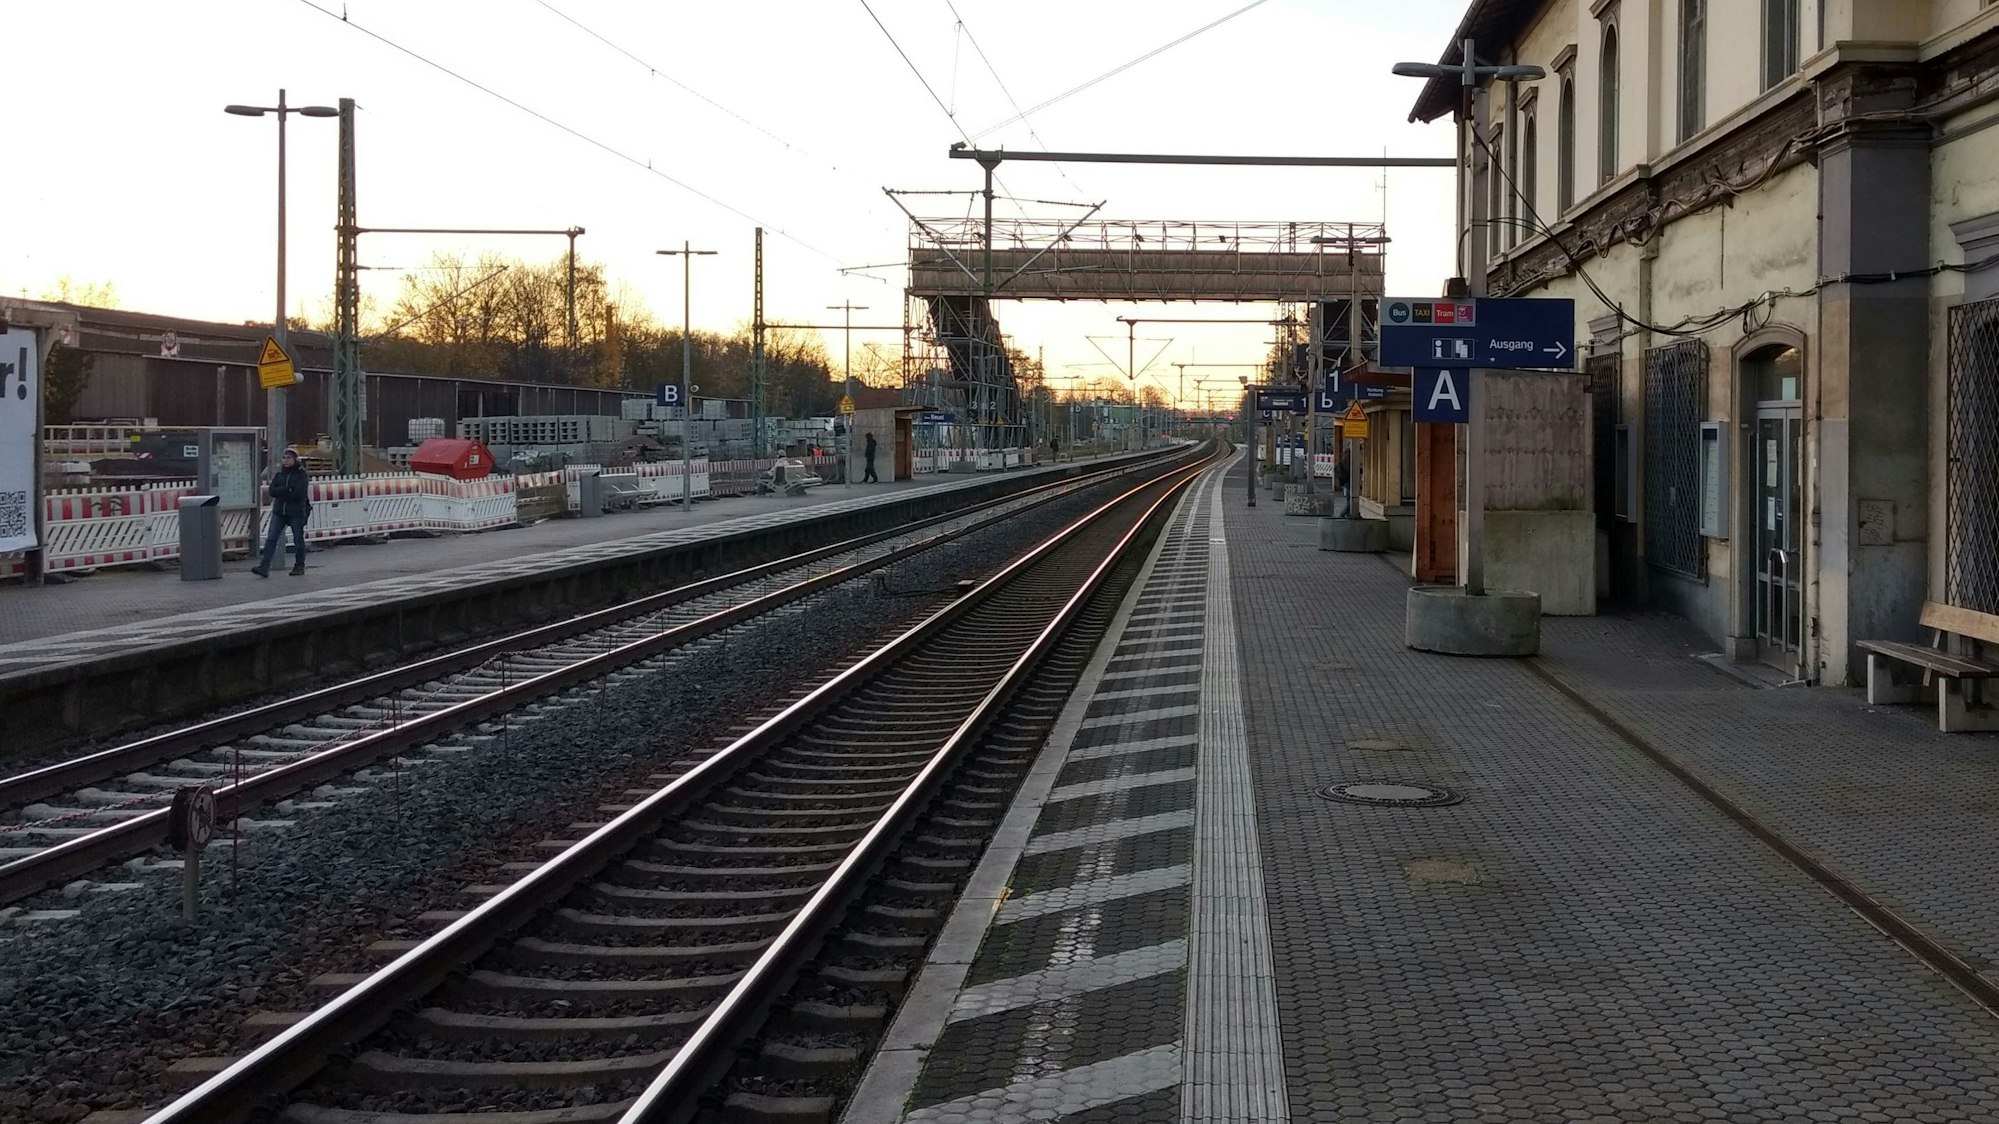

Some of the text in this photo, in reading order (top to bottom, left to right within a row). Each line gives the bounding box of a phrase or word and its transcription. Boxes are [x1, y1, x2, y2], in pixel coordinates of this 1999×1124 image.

[1392, 308, 1407, 317] Bus
[1436, 309, 1454, 317] Tram
[1489, 338, 1534, 351] Ausgang
[1329, 369, 1339, 393] 1
[664, 384, 678, 402] B
[1427, 369, 1462, 410] A
[971, 401, 978, 410] 3
[990, 401, 996, 410] 2
[1300, 397, 1307, 408] 1
[1321, 392, 1334, 409] b
